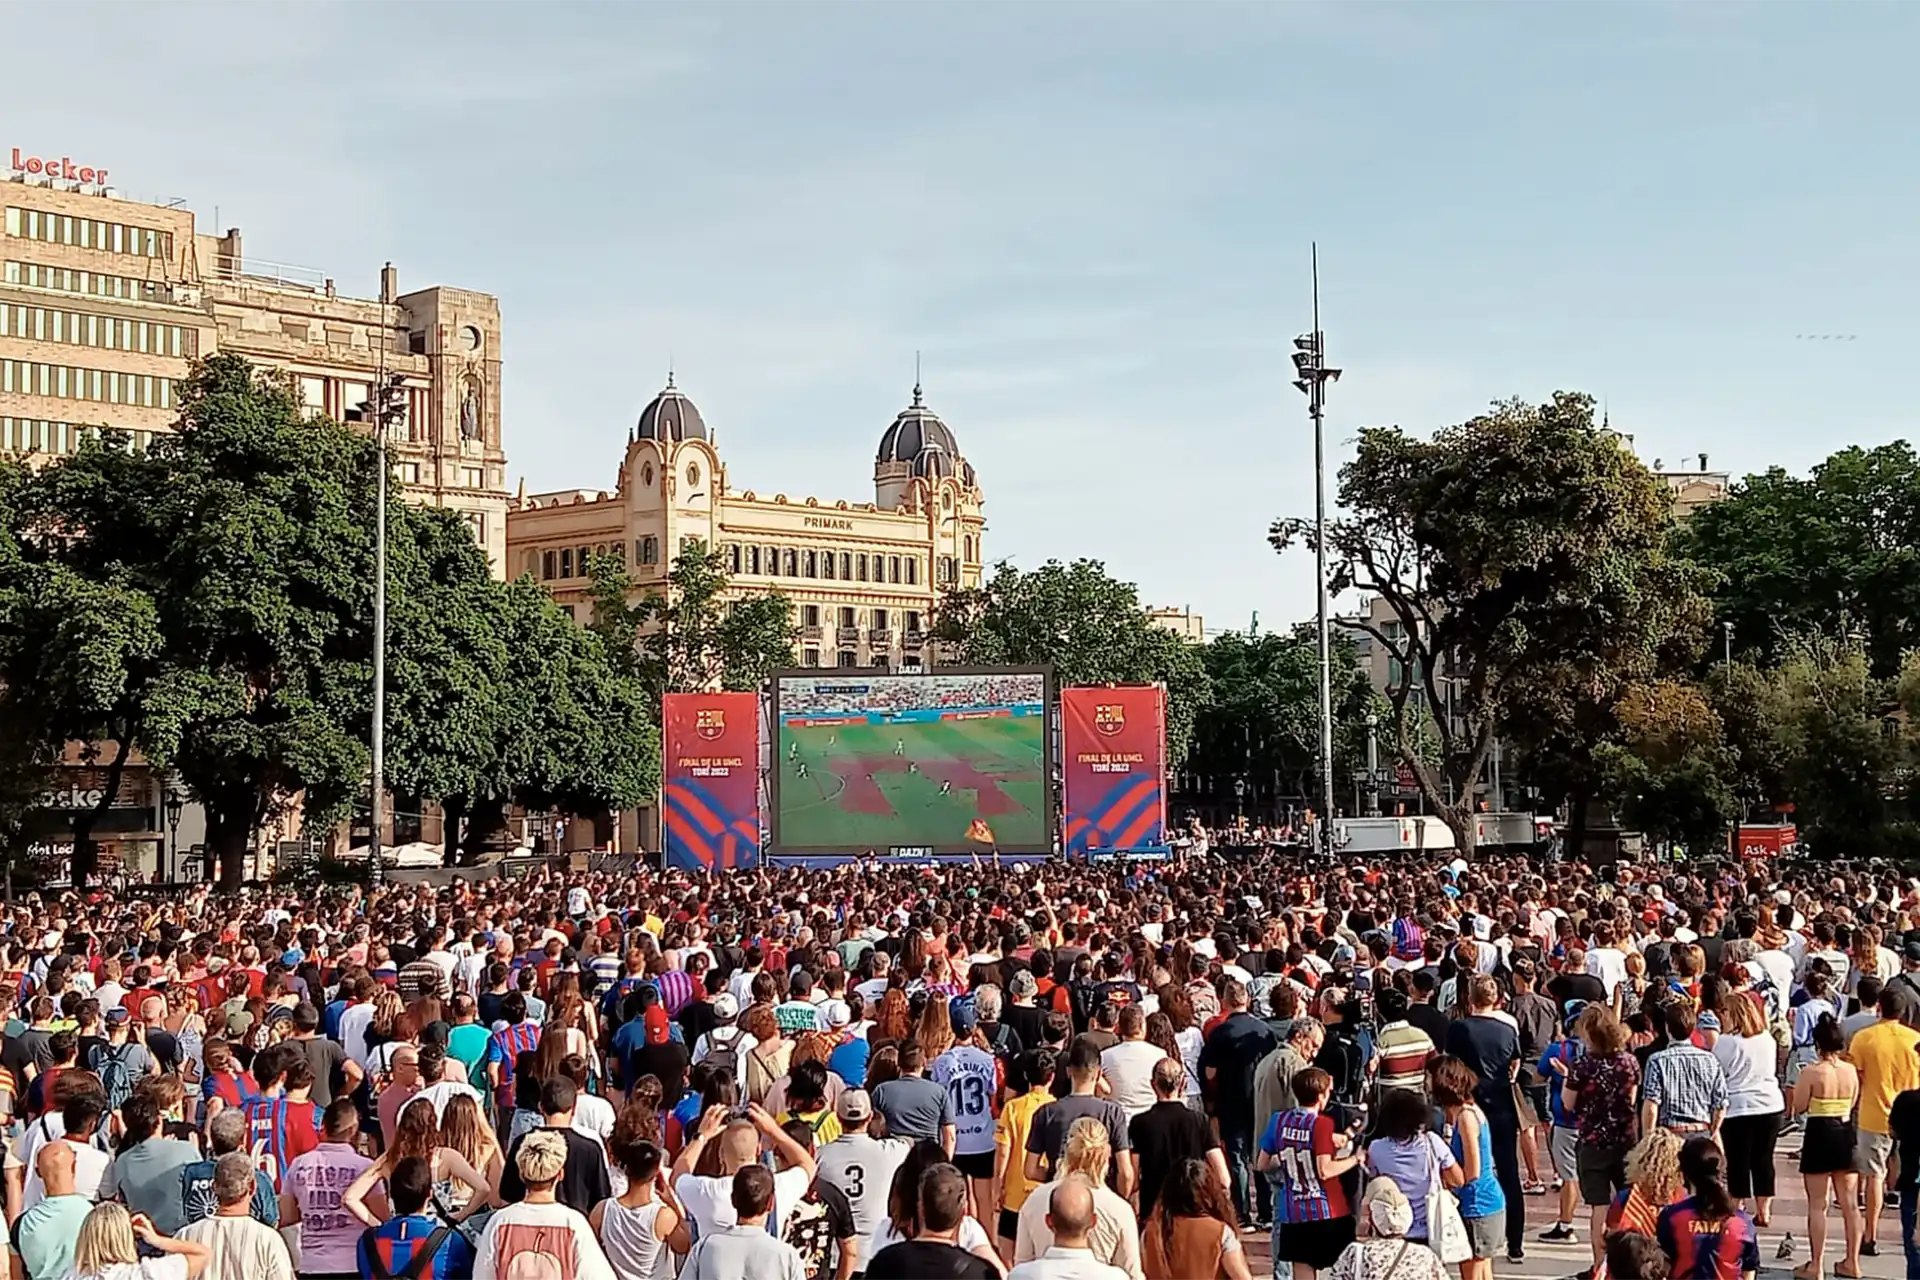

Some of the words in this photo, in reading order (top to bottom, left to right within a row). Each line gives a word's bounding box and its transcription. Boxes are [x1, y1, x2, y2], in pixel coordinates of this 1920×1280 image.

[12, 148, 108, 185] Locker
[804, 516, 853, 530] PRIMARK
[1744, 844, 1768, 855] Ask
[949, 1076, 984, 1117] 13
[844, 1163, 865, 1199] 3
[1280, 1146, 1321, 1193] 11
